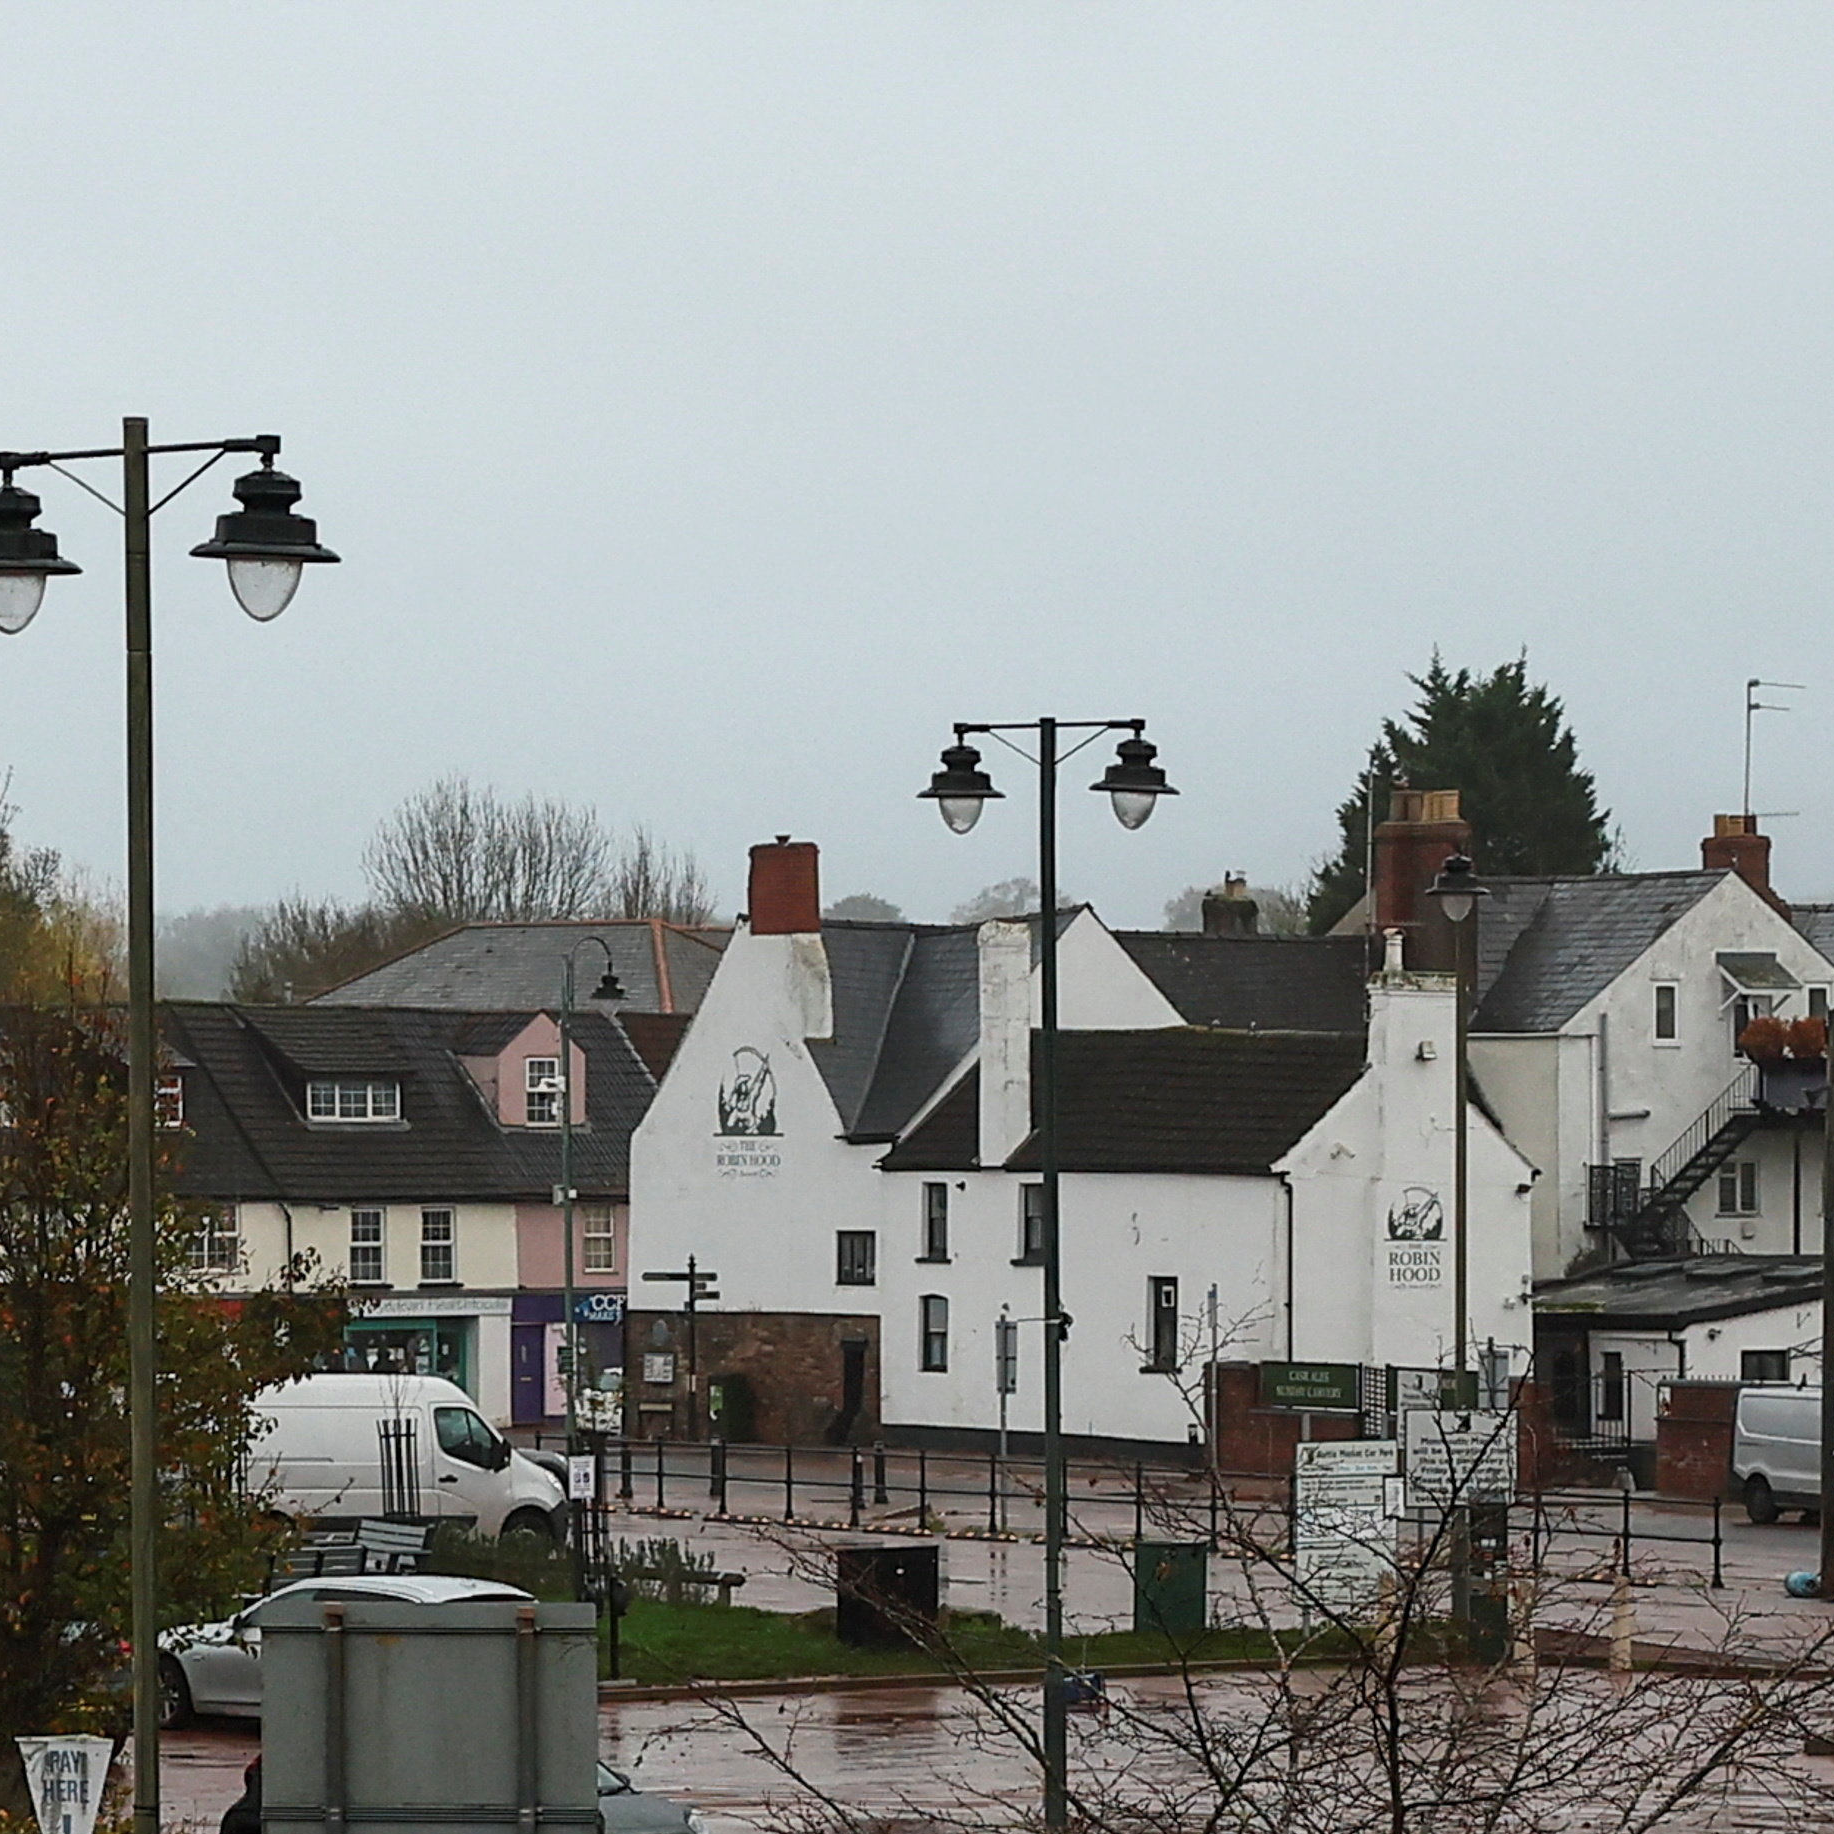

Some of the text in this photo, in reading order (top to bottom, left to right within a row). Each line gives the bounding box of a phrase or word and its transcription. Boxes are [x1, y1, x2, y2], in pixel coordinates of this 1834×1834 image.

[739, 1140, 758, 1151] THE
[717, 1154, 781, 1167] ROBIN HOOD
[1389, 1251, 1441, 1266] ROBIN
[1389, 1267, 1441, 1282] HOOD
[49, 1750, 81, 1774] PAY
[43, 1780, 90, 1804] HERE
